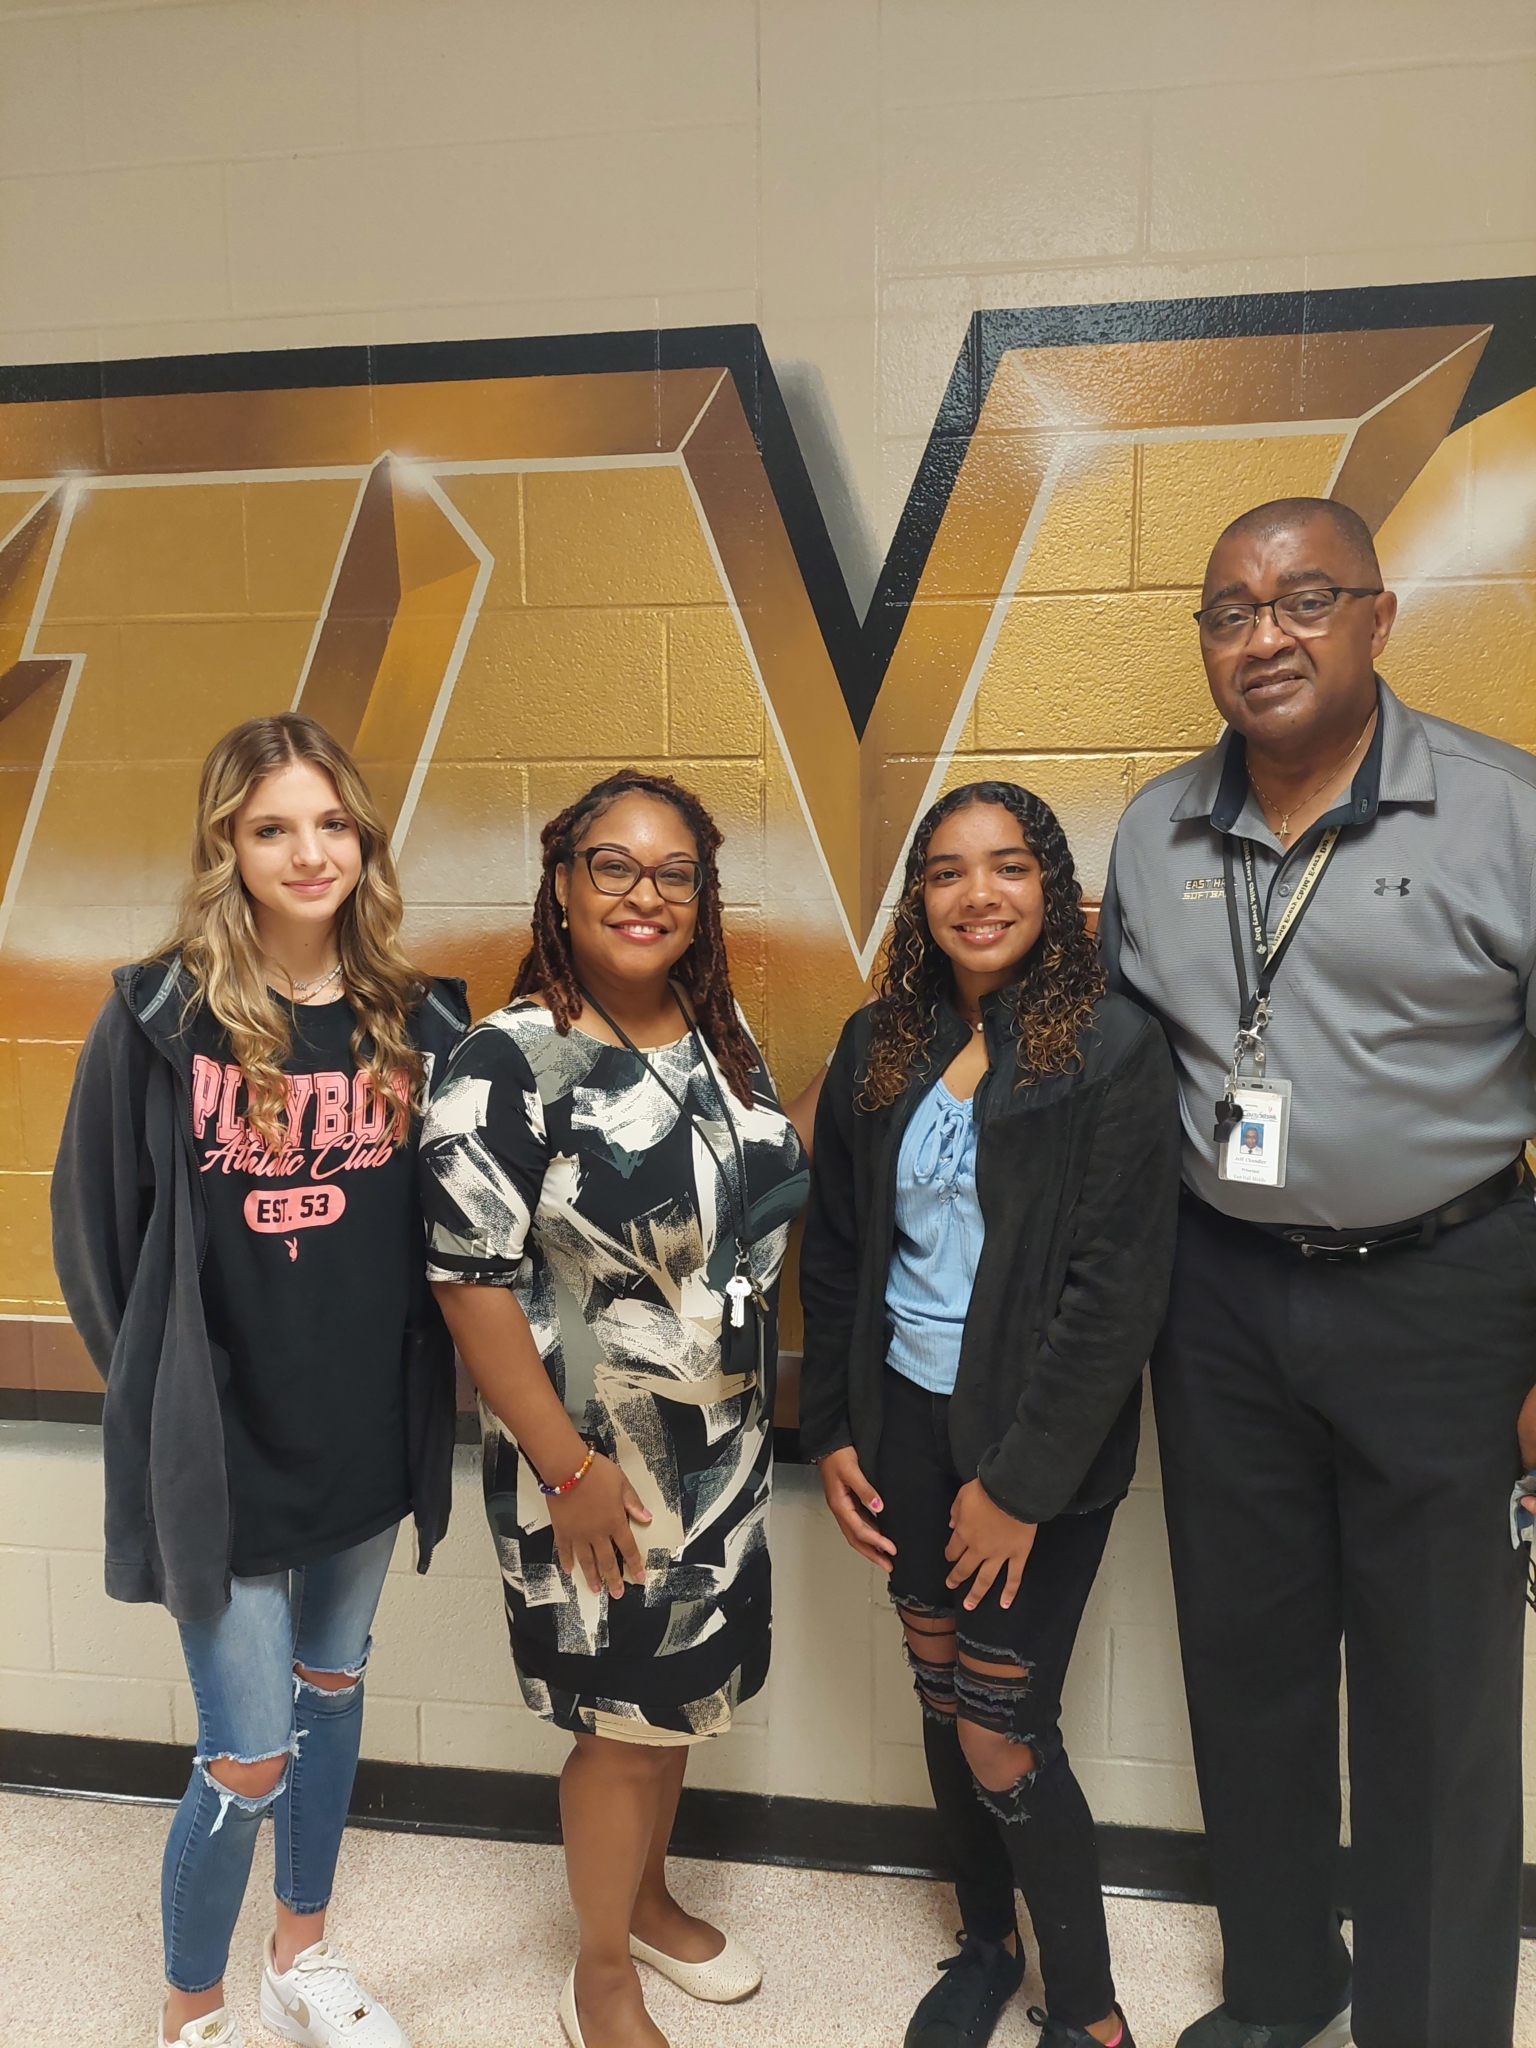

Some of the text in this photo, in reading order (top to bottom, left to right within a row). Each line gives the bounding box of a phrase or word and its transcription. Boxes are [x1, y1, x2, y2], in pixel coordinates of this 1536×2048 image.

[1182, 889, 1238, 900] SOFTBA
[1185, 879, 1211, 890] EAST
[1248, 882, 1256, 905] Child,
[1251, 904, 1259, 926] Every
[1254, 926, 1262, 941] Day
[192, 1054, 411, 1150] PLYBOY
[200, 1131, 393, 1180] Athletic Club
[257, 1193, 330, 1223] EST. 53
